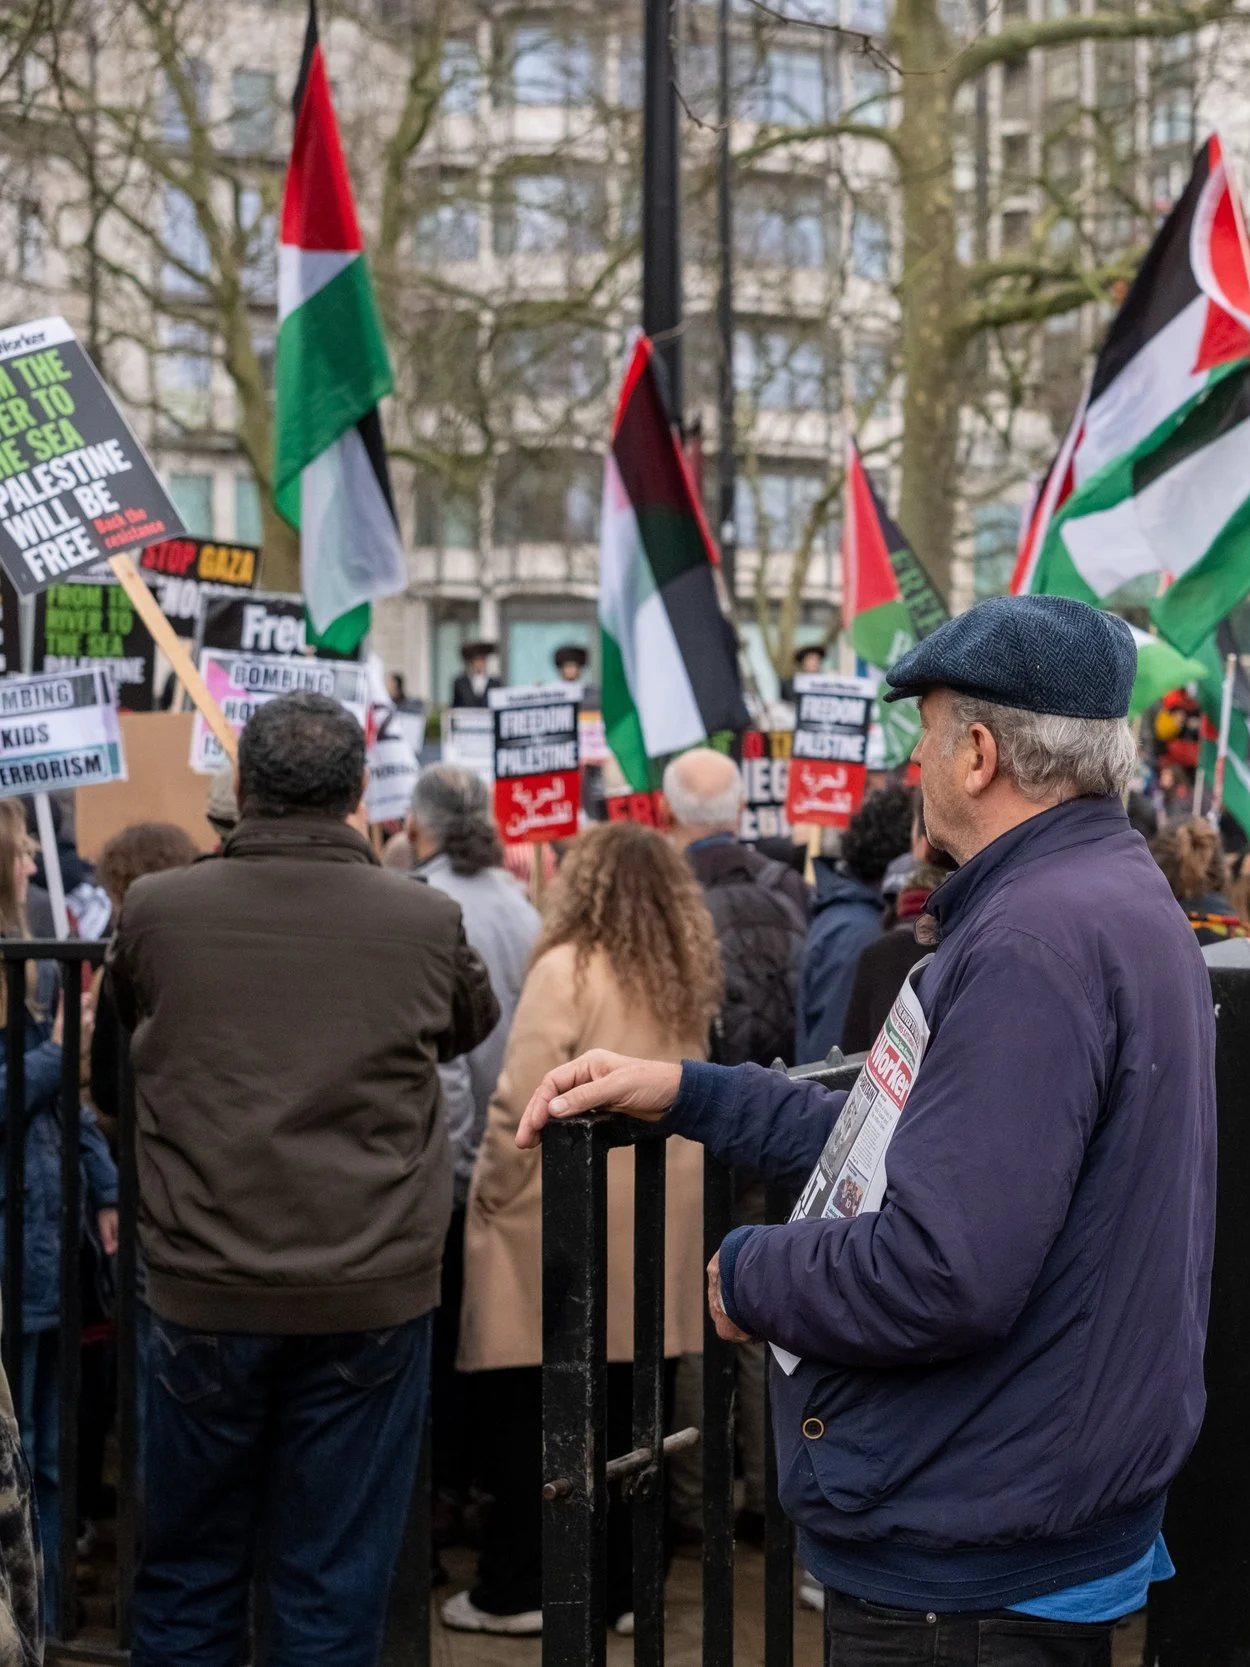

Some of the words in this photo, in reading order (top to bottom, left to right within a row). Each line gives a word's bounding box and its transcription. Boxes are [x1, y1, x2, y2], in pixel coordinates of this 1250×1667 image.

[11, 349, 72, 390] THE
[31, 384, 76, 420] TO
[25, 418, 85, 461] SEA
[0, 438, 133, 519] PALESTINE
[2, 498, 82, 551] WILL
[72, 480, 120, 521] BE
[22, 526, 99, 582] FREE
[141, 540, 196, 575] STOP
[198, 544, 255, 585] GAZA
[233, 664, 332, 693] BOMBING
[2, 724, 49, 750] KIDS
